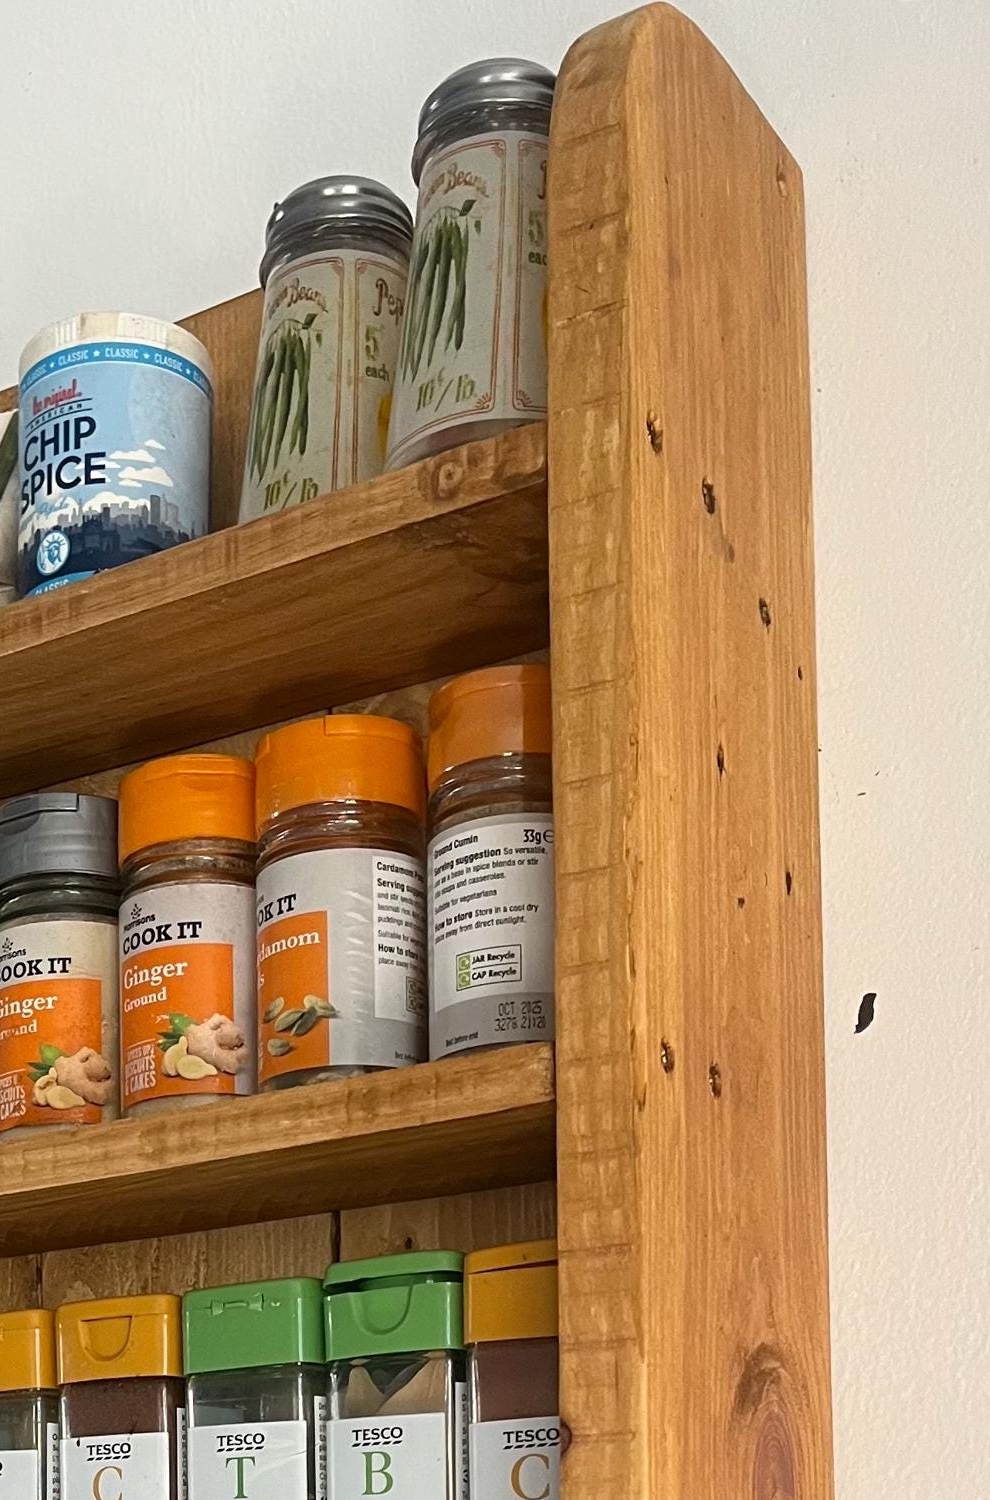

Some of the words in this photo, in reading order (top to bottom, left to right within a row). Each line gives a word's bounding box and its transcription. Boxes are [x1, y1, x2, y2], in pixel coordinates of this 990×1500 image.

[58, 350, 89, 365] CLASSIC
[105, 348, 139, 359] CLASSIC
[154, 353, 183, 372] CLASSIC
[24, 416, 97, 472] CHIP
[21, 452, 106, 515] SPICE
[454, 835, 478, 849] Cumin
[523, 829, 541, 844] 33g
[456, 848, 501, 865] suggestion
[377, 878, 405, 892] Serving
[277, 893, 297, 913] IT
[454, 911, 473, 923] store
[123, 924, 174, 955] COOK
[177, 921, 202, 939] IT
[257, 930, 321, 966] damom
[378, 944, 395, 953] How
[487, 951, 515, 961] Recycle
[48, 957, 72, 974] IT
[123, 960, 188, 990] Ginger
[472, 972, 487, 980] CAP
[488, 967, 517, 978] Recycle
[123, 989, 167, 1013] Ground
[216, 1433, 265, 1447] TESCO
[352, 1426, 403, 1442] TESCO
[503, 1427, 561, 1444] TESCO
[86, 1442, 131, 1456] TESCO
[225, 1456, 256, 1499] T
[362, 1451, 394, 1496] B
[510, 1453, 551, 1500] C
